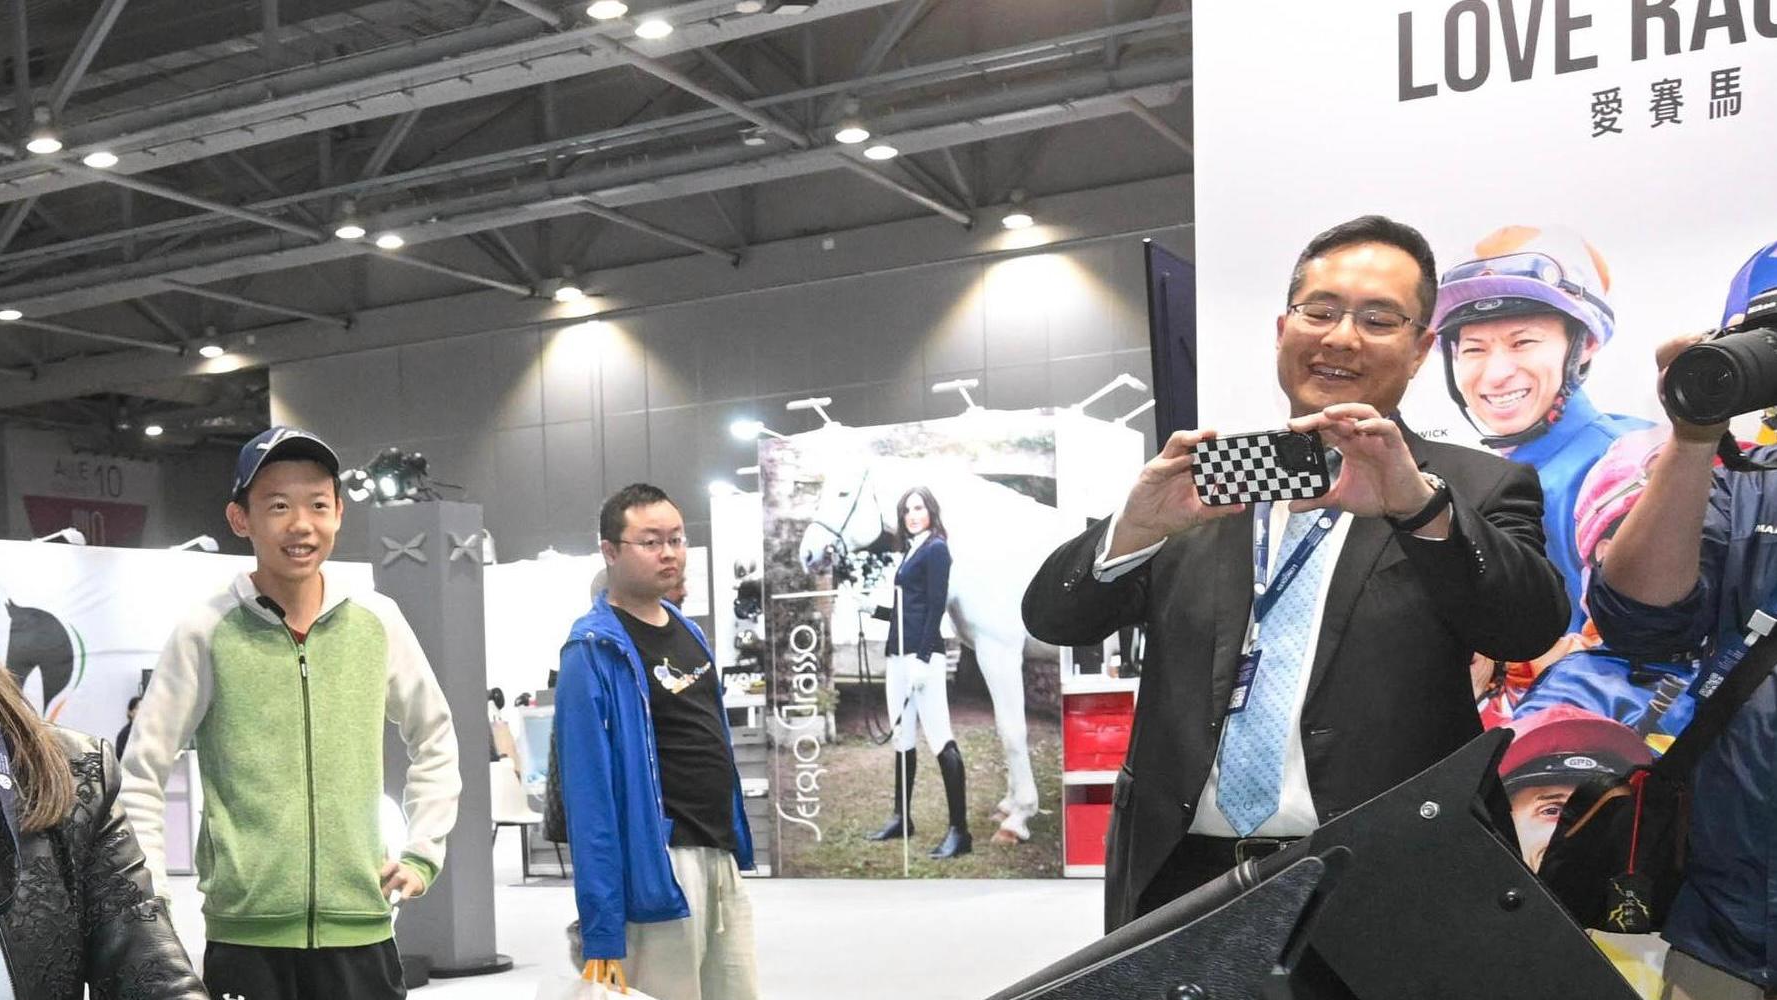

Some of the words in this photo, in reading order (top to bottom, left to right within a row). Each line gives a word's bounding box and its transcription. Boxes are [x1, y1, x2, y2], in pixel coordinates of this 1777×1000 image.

[1397, 0, 1599, 102] LOVE
[1590, 66, 1743, 138] 愛賽馬
[1418, 428, 1449, 438] WICK
[94, 464, 124, 498] 10
[774, 624, 821, 731] Grasso
[775, 734, 828, 842] Sergio
